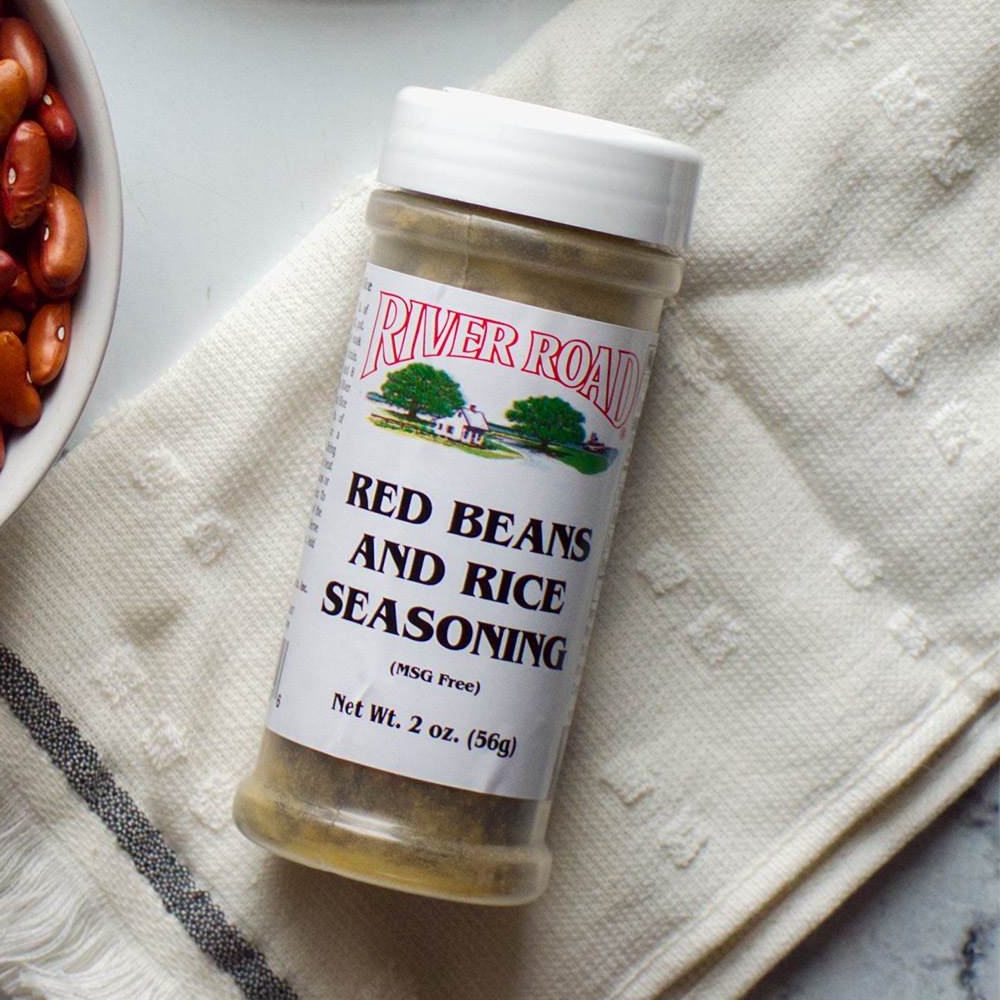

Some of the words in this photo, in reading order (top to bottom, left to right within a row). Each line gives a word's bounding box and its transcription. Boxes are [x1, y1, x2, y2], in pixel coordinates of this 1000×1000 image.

[360, 290, 519, 380] RIVER
[521, 330, 640, 430] ROAD
[345, 471, 433, 525] RED
[446, 500, 593, 562] BEANS
[348, 533, 446, 586] AND
[460, 561, 567, 615] RICE
[321, 580, 567, 671] SEASONING
[389, 661, 433, 683] (MSG
[437, 673, 481, 696] Free)
[331, 692, 364, 718] Net
[369, 703, 401, 729] Wt.
[408, 715, 423, 734] 2
[428, 723, 460, 743] oz.
[467, 729, 517, 758] (56g)
